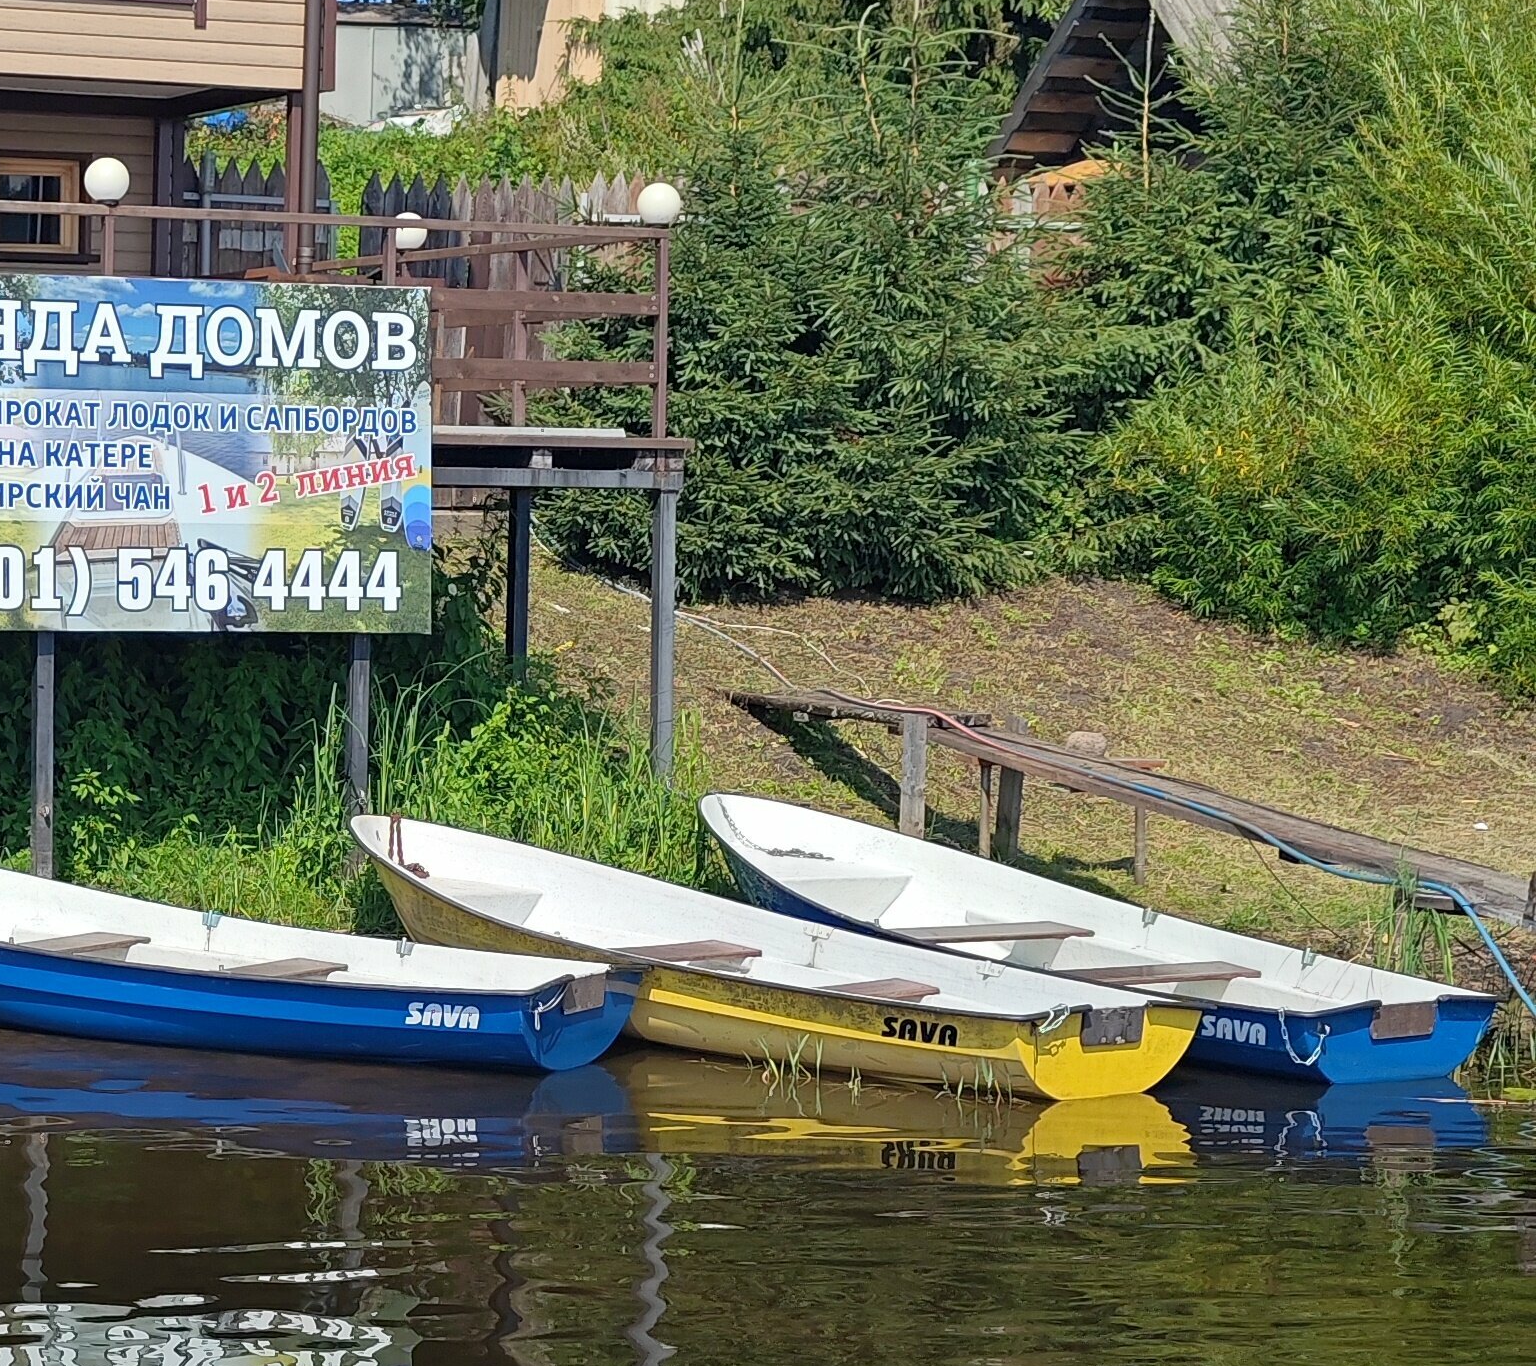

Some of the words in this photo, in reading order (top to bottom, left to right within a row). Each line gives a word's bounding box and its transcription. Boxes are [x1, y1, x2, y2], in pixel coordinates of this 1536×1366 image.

[149, 303, 416, 380] ДОМОВ
[107, 403, 210, 433] ЛОДОК
[220, 405, 237, 430] И
[246, 406, 417, 436] САПБОРДОВ
[45, 443, 152, 468] КАТЕРЕ
[114, 485, 170, 510] ЧАН
[198, 484, 215, 513] 1
[224, 487, 249, 510] и
[256, 472, 278, 503] 2
[296, 455, 415, 497] линия
[116, 546, 231, 612] 546
[252, 548, 402, 613] 4444
[405, 1001, 480, 1031] SAVA
[882, 1016, 958, 1047] SAVA
[1201, 1015, 1267, 1046] SAVA
